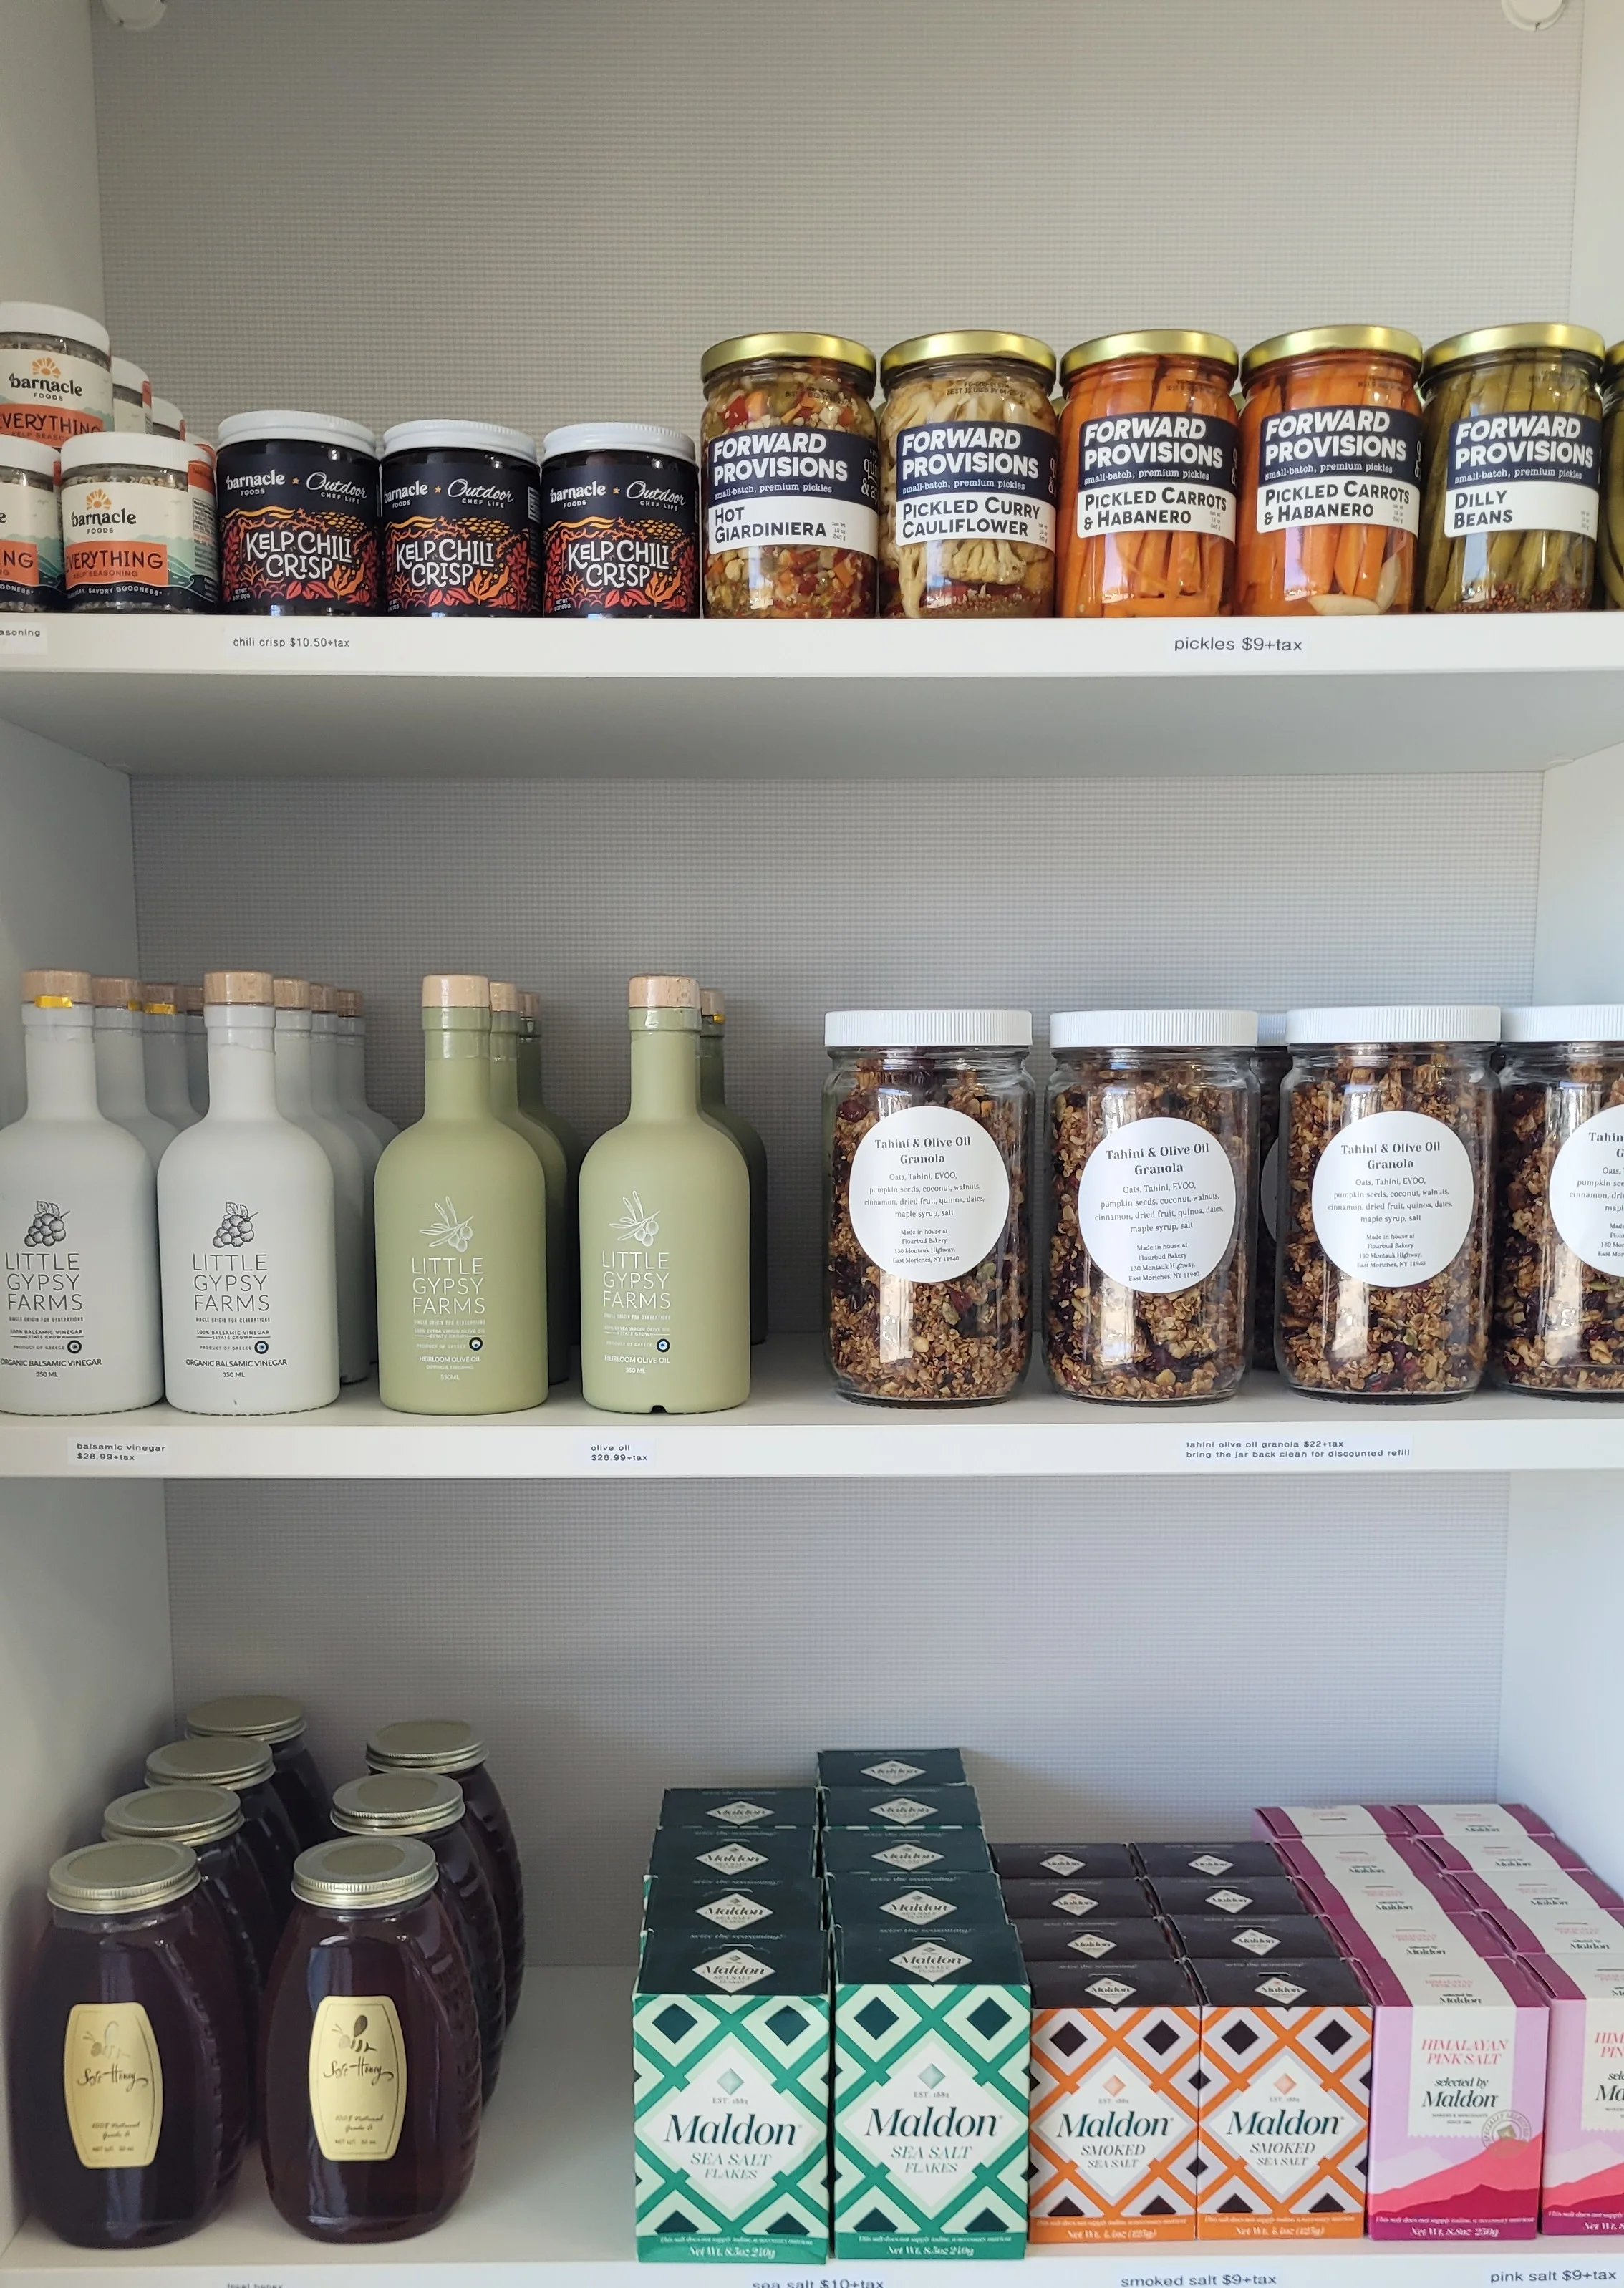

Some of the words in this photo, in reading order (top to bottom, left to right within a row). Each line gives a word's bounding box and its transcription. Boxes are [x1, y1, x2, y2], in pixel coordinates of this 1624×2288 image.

[9, 373, 83, 397] barnacle
[33, 392, 64, 402] FOODS
[1084, 417, 1206, 447] FORWARD
[1265, 410, 1390, 442] FORWARD
[1455, 415, 1580, 445] FORWARD
[713, 432, 826, 463] FORWARD
[902, 428, 1021, 456] FORWARD
[1265, 435, 1407, 466] PROVISIONS
[1084, 442, 1222, 471] PROVISIONS
[1455, 440, 1593, 470] PROVISIONS
[714, 456, 848, 487] PROVISIONS
[903, 452, 1039, 481] PROVISIONS
[226, 470, 286, 491] barnacle
[306, 472, 367, 499] Outdoor
[759, 483, 799, 493] premium
[803, 483, 832, 493] pickles
[954, 479, 995, 488] premium
[998, 480, 1025, 491] pickles
[321, 491, 342, 500] CHEF
[344, 496, 360, 505] LIFE
[626, 481, 686, 506] Outdoor
[1085, 491, 1156, 511] PICKLED
[1161, 486, 1227, 511] CARROTS
[1265, 484, 1338, 506] PICKLED
[1343, 481, 1410, 504] CARROTS
[1455, 490, 1507, 510] DILLY
[71, 508, 137, 527] barnacle
[715, 506, 745, 526] HOT
[903, 500, 978, 521] PICKLED
[985, 496, 1040, 520] CURRY
[1264, 511, 1273, 526] &
[1278, 503, 1373, 523] HABANERO
[902, 518, 1028, 538] CAULIFLOWER
[1083, 516, 1093, 531] &
[1098, 510, 1192, 528] HABANERO
[1454, 509, 1513, 529] BEANS
[715, 521, 827, 544] GIARDINIERA
[246, 531, 295, 561] KELP
[297, 531, 352, 563] CHILI
[396, 541, 436, 573] KELP
[438, 539, 495, 568] CHILI
[568, 542, 614, 572] KELP
[617, 539, 670, 570] CHILI
[266, 554, 333, 580] CRISP
[411, 561, 473, 588] CRISP
[586, 562, 650, 589] CRISP
[233, 637, 255, 647] chili
[258, 637, 286, 648] crisp
[289, 637, 350, 647] $10.50+tax
[1174, 637, 1235, 652] pickles
[1242, 637, 1302, 651] $9+tax
[875, 1139, 909, 1149] Tahini
[912, 1138, 920, 1148] &
[924, 1137, 952, 1147] Olive
[955, 1136, 971, 1146] Oil
[1106, 1148, 1144, 1159] Tahini
[1148, 1147, 1156, 1157] &
[1160, 1146, 1190, 1157] Olive
[1194, 1143, 1209, 1154] Oil
[1341, 1144, 1377, 1154] Tahini
[1381, 1144, 1388, 1153] &
[1393, 1143, 1421, 1152] Olive
[1425, 1141, 1440, 1152] Oil
[900, 1154, 945, 1164] Granola
[1368, 1159, 1413, 1169] Granola
[1134, 1163, 1183, 1175] Granola
[1101, 1199, 1133, 1210] pumpkin
[5, 1252, 80, 1270] LITTLE
[193, 1253, 268, 1271] LITTLE
[412, 1257, 483, 1275] LITTLE
[602, 1250, 670, 1270] LITTLE
[7, 1273, 80, 1291] GYPSY
[194, 1275, 267, 1292] GYPSY
[412, 1278, 483, 1295] GYPSY
[603, 1271, 670, 1289] GYPSY
[8, 1293, 82, 1311] FARMS
[195, 1295, 269, 1312] FARMS
[413, 1297, 485, 1315] FARMS
[603, 1290, 670, 1310] FARMS
[186, 1358, 214, 1367] ORGANIC
[254, 1358, 287, 1367] VINEGAR
[127, 1444, 165, 1453] vinegar
[899, 1955, 963, 1965] Maldon
[702, 1965, 765, 1975] Maldon
[1421, 2039, 1508, 2052] HIMALAYAN
[1427, 2053, 1462, 2065] PINK
[1464, 2053, 1502, 2065] SALT
[1434, 2077, 1475, 2088] selected
[1476, 2078, 1489, 2090] by
[1421, 2090, 1499, 2108] Maldon
[664, 2113, 797, 2145] Maldon
[864, 2106, 997, 2138] Maldon
[1056, 2110, 1169, 2138] Maldon
[1227, 2108, 1340, 2135] Maldon
[891, 2146, 923, 2158] SEA
[929, 2146, 972, 2158] SALT
[1081, 2144, 1146, 2156] SMOKED
[1250, 2142, 1315, 2154] SMOKED
[691, 2153, 722, 2166] SEA
[728, 2153, 771, 2166] SALT
[905, 2163, 958, 2173] FLAKES
[1087, 2159, 1108, 2168] SEA
[1111, 2159, 1139, 2168] SALT
[1257, 2157, 1278, 2166] SEA
[1280, 2157, 1309, 2166] SALT
[705, 2168, 758, 2179] FLAKES
[1121, 2275, 1184, 2287] smoked
[1189, 2275, 1217, 2286] salt
[1222, 2274, 1277, 2286] $9+tax
[1490, 2270, 1524, 2283] pink
[1529, 2269, 1557, 2282] salt
[1562, 2269, 1617, 2282] $9+tax
